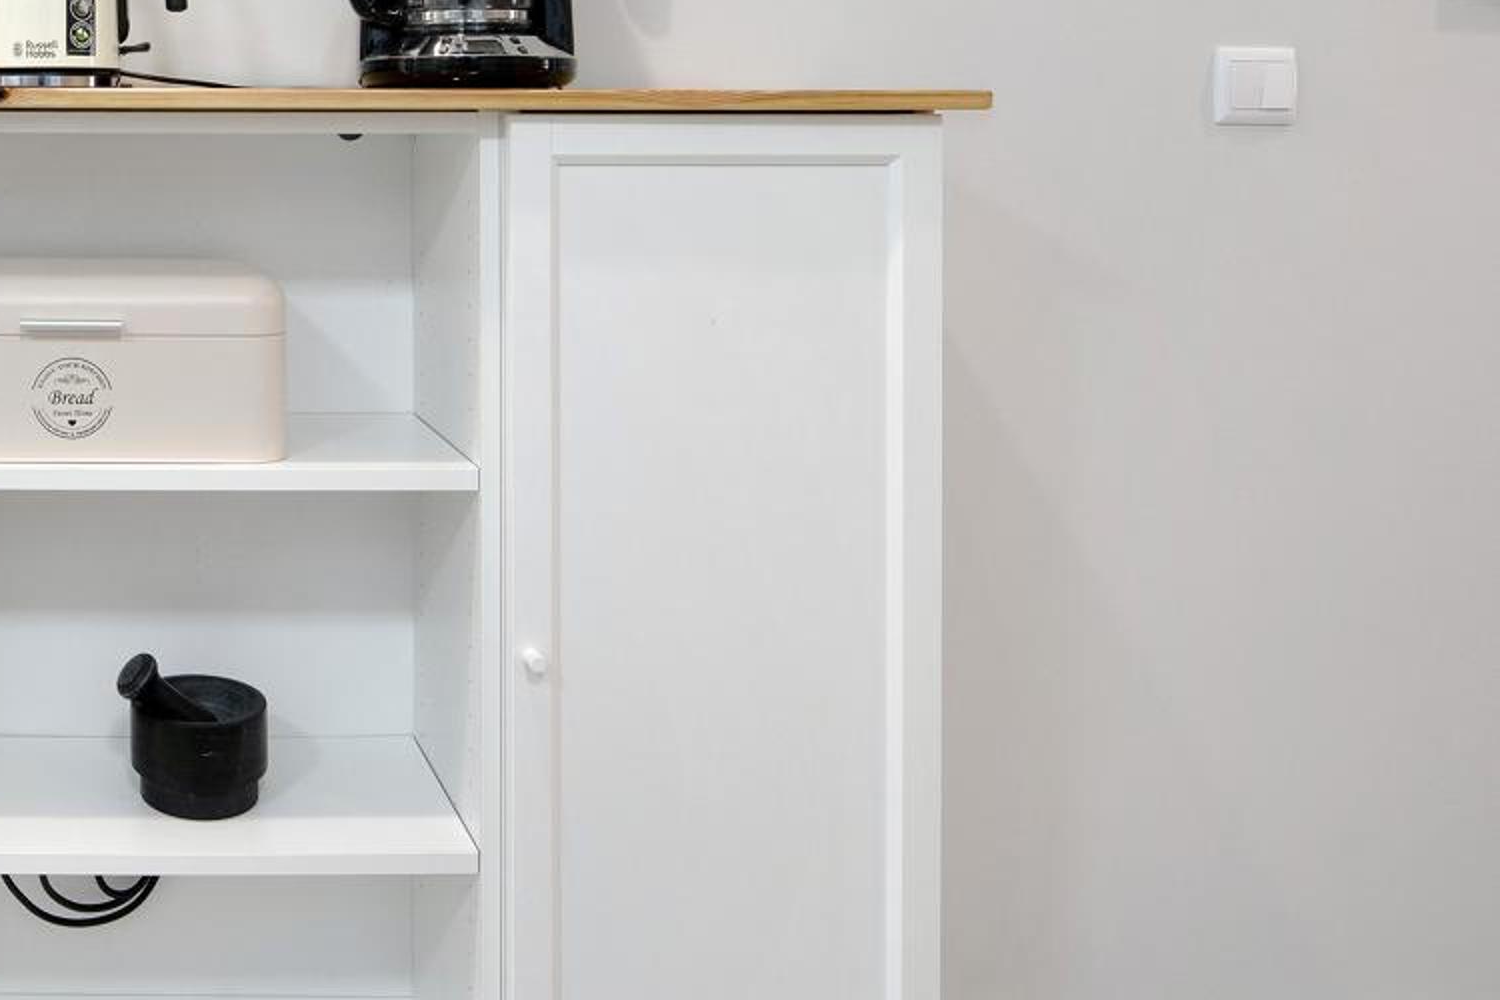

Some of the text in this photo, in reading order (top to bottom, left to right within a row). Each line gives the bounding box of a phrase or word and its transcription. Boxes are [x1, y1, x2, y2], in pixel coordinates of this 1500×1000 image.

[25, 39, 59, 50] Russell
[25, 49, 57, 59] Hobbs
[47, 387, 99, 406] Bread
